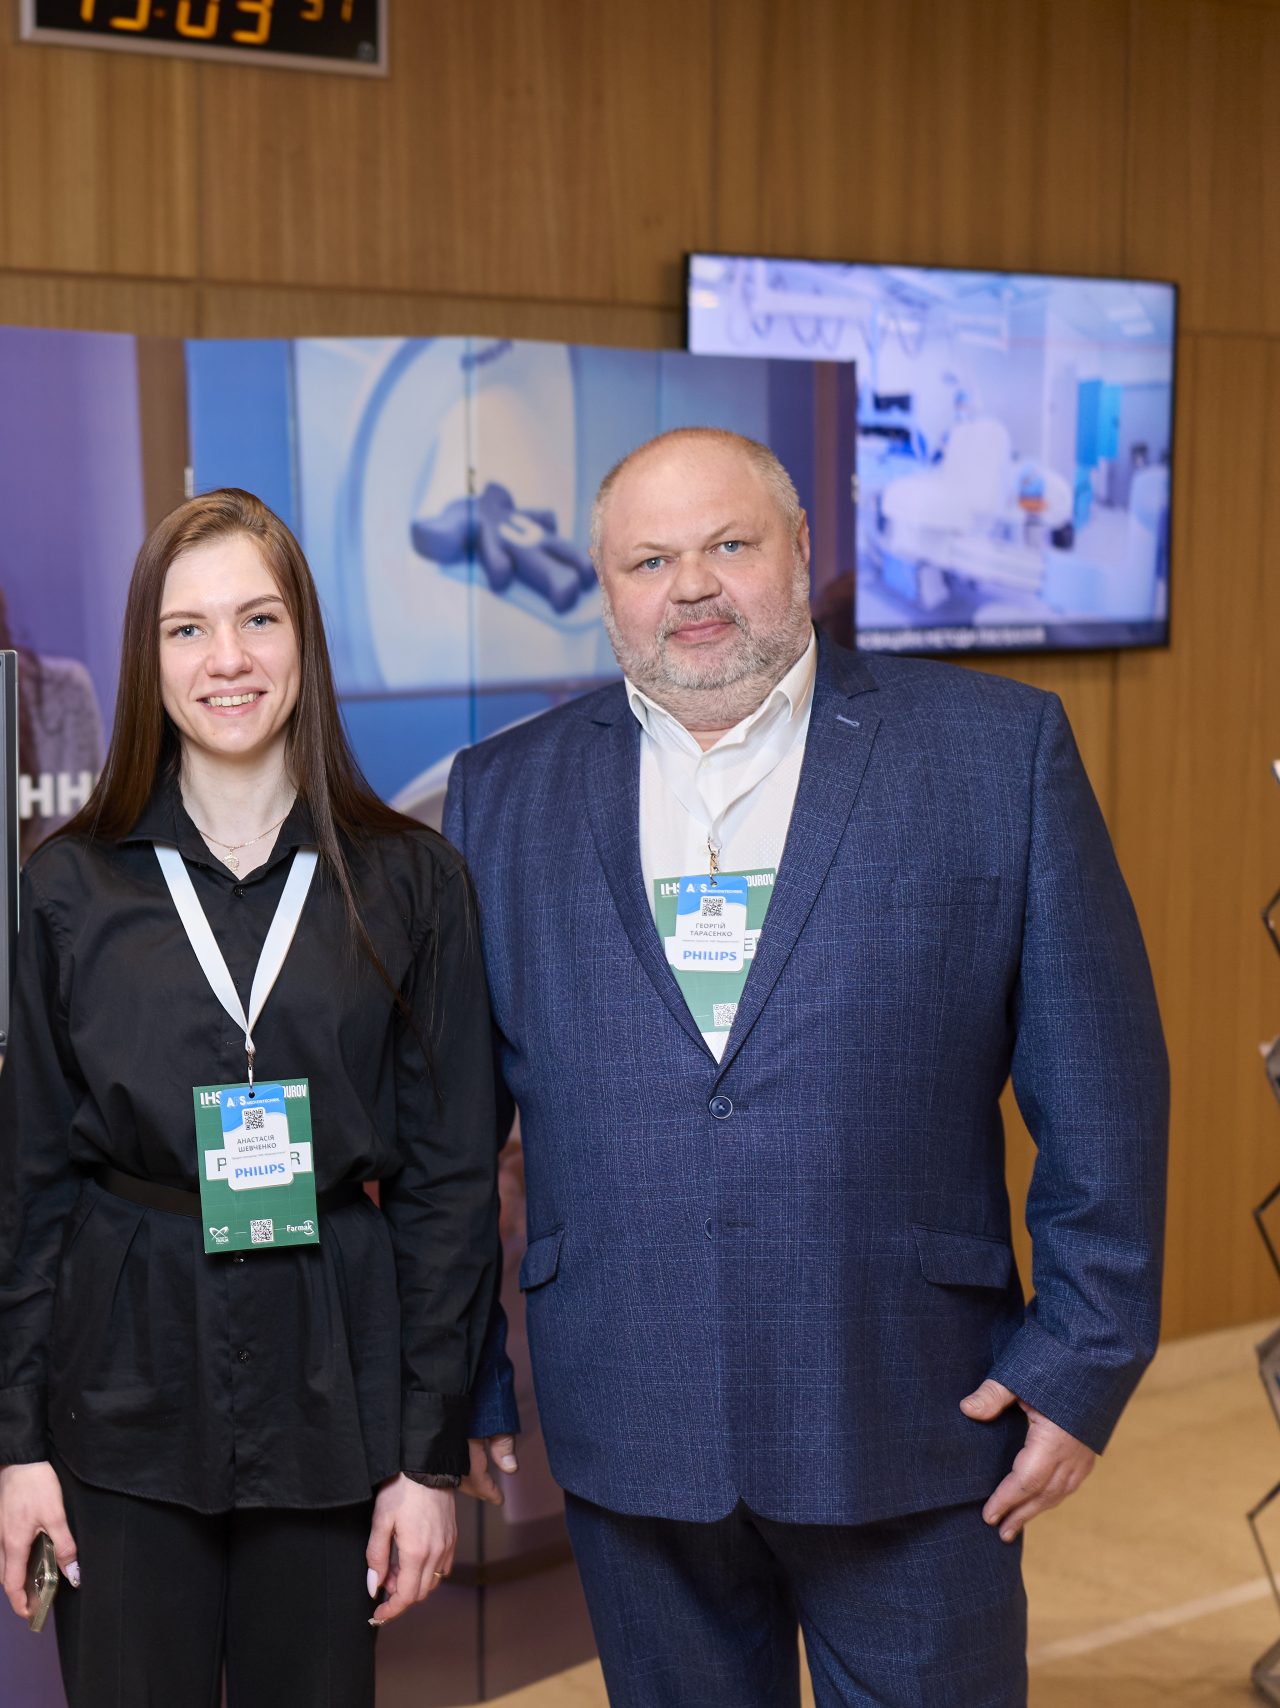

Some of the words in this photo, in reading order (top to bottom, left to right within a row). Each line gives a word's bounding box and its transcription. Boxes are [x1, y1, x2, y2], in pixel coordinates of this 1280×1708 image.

[695, 922, 726, 930] ГЕОРГІЙ
[683, 950, 737, 961] PHILIPS
[237, 1134, 275, 1145] АНАСТАСІЯ
[238, 1142, 277, 1153] ШЕВЧЕНКО
[234, 1162, 286, 1179] PHILIPS
[286, 1223, 313, 1233] Farmak
